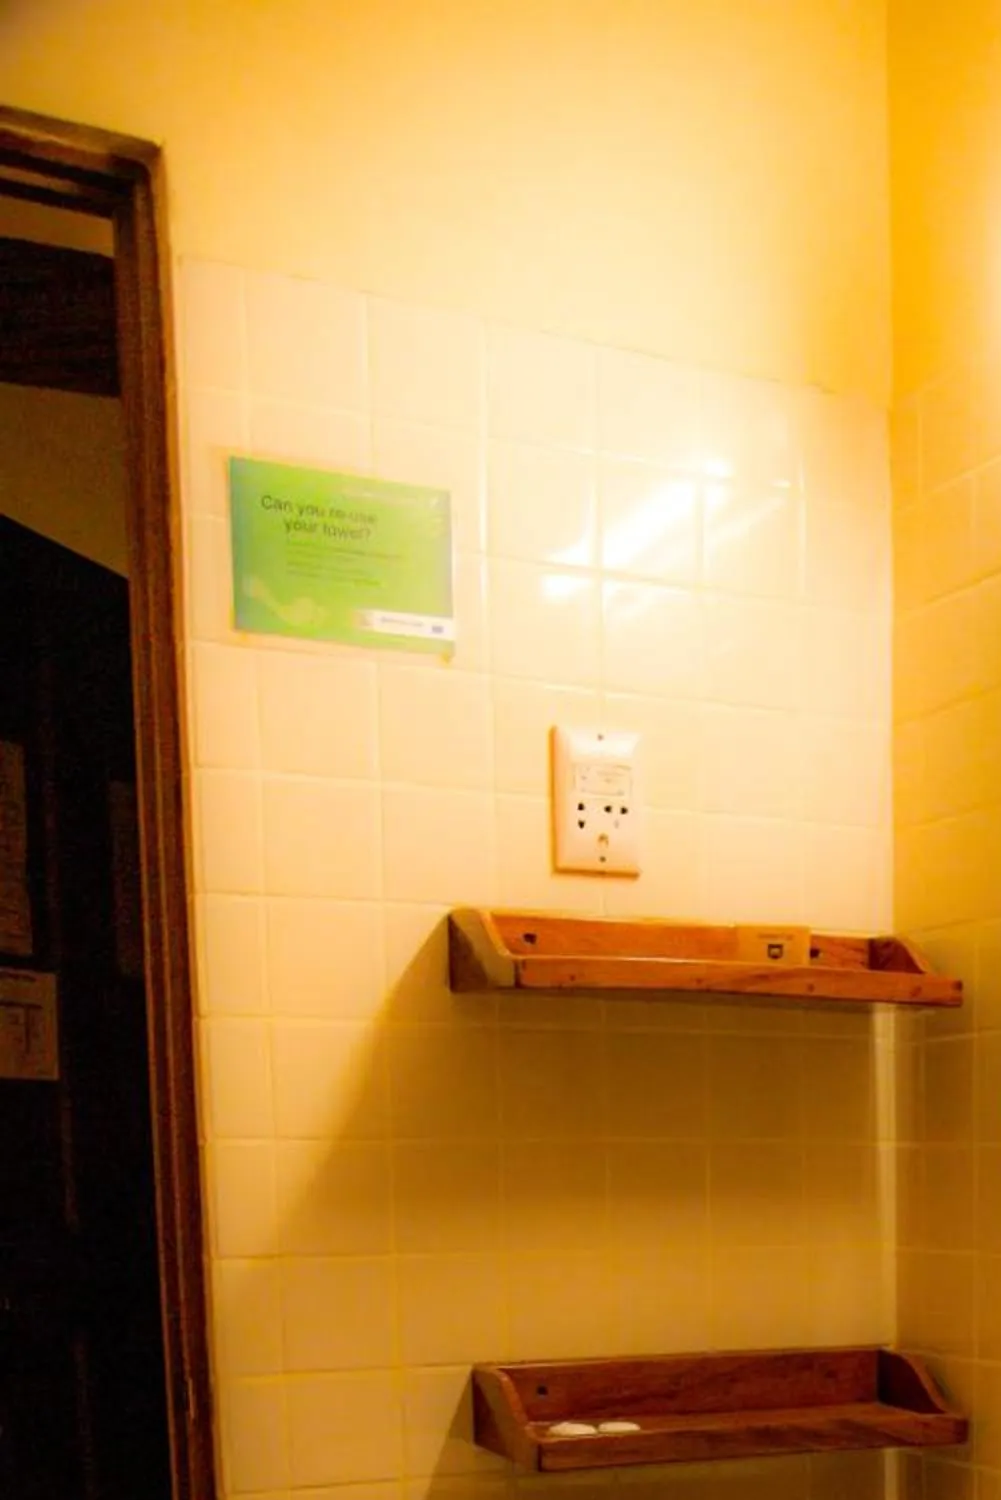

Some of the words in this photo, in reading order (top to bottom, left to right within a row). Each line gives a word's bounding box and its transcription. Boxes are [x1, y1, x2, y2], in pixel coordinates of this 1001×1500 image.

[261, 494, 292, 512] Can
[296, 503, 325, 519] you
[283, 517, 317, 535] your
